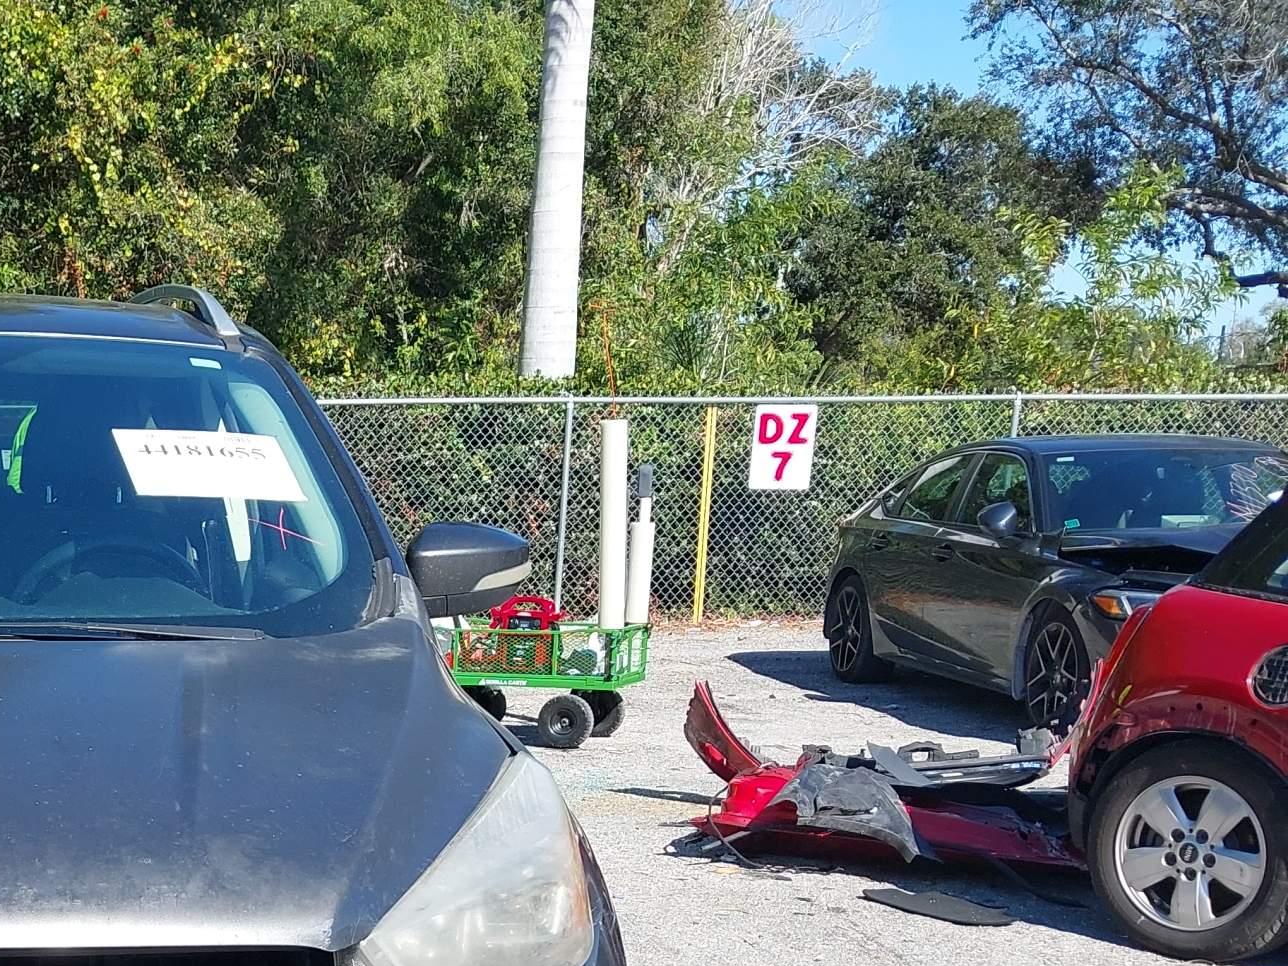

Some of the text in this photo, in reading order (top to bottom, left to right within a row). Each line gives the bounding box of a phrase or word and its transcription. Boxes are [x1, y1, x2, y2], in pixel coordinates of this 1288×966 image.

[758, 413, 809, 444] DZ
[138, 444, 267, 460] 44181655
[771, 450, 793, 481] 7
